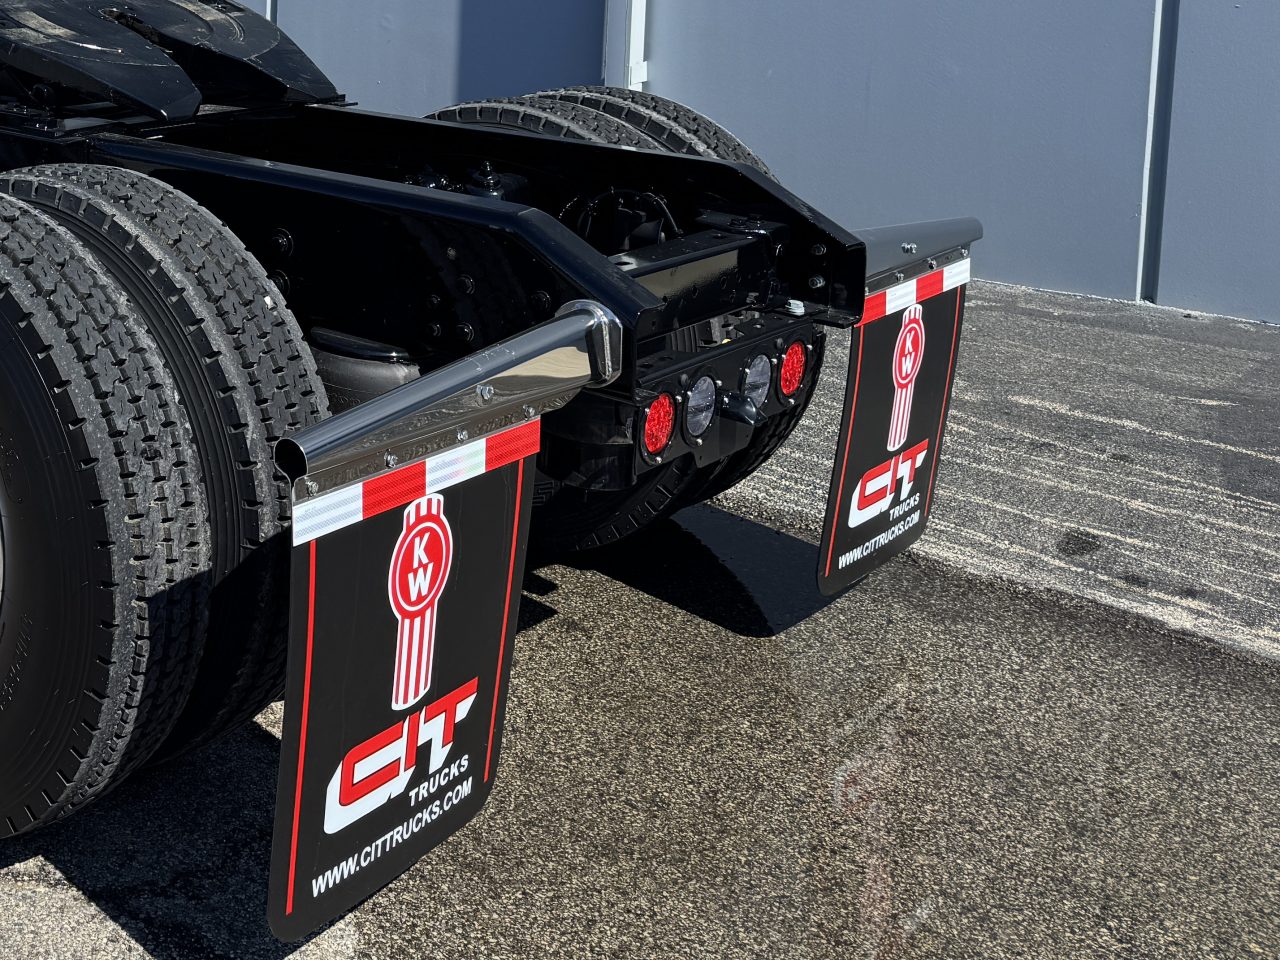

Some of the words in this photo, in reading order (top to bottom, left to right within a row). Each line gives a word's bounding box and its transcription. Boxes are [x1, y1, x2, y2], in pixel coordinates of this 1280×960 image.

[850, 438, 928, 526] CIT
[889, 492, 920, 522] TRUCKS
[838, 509, 921, 570] WWW.CITTRUCKS.COM
[327, 677, 478, 827] CIT
[408, 753, 469, 807] TRUCKS
[311, 775, 473, 898] WWW.CITTRUCKS.COM
